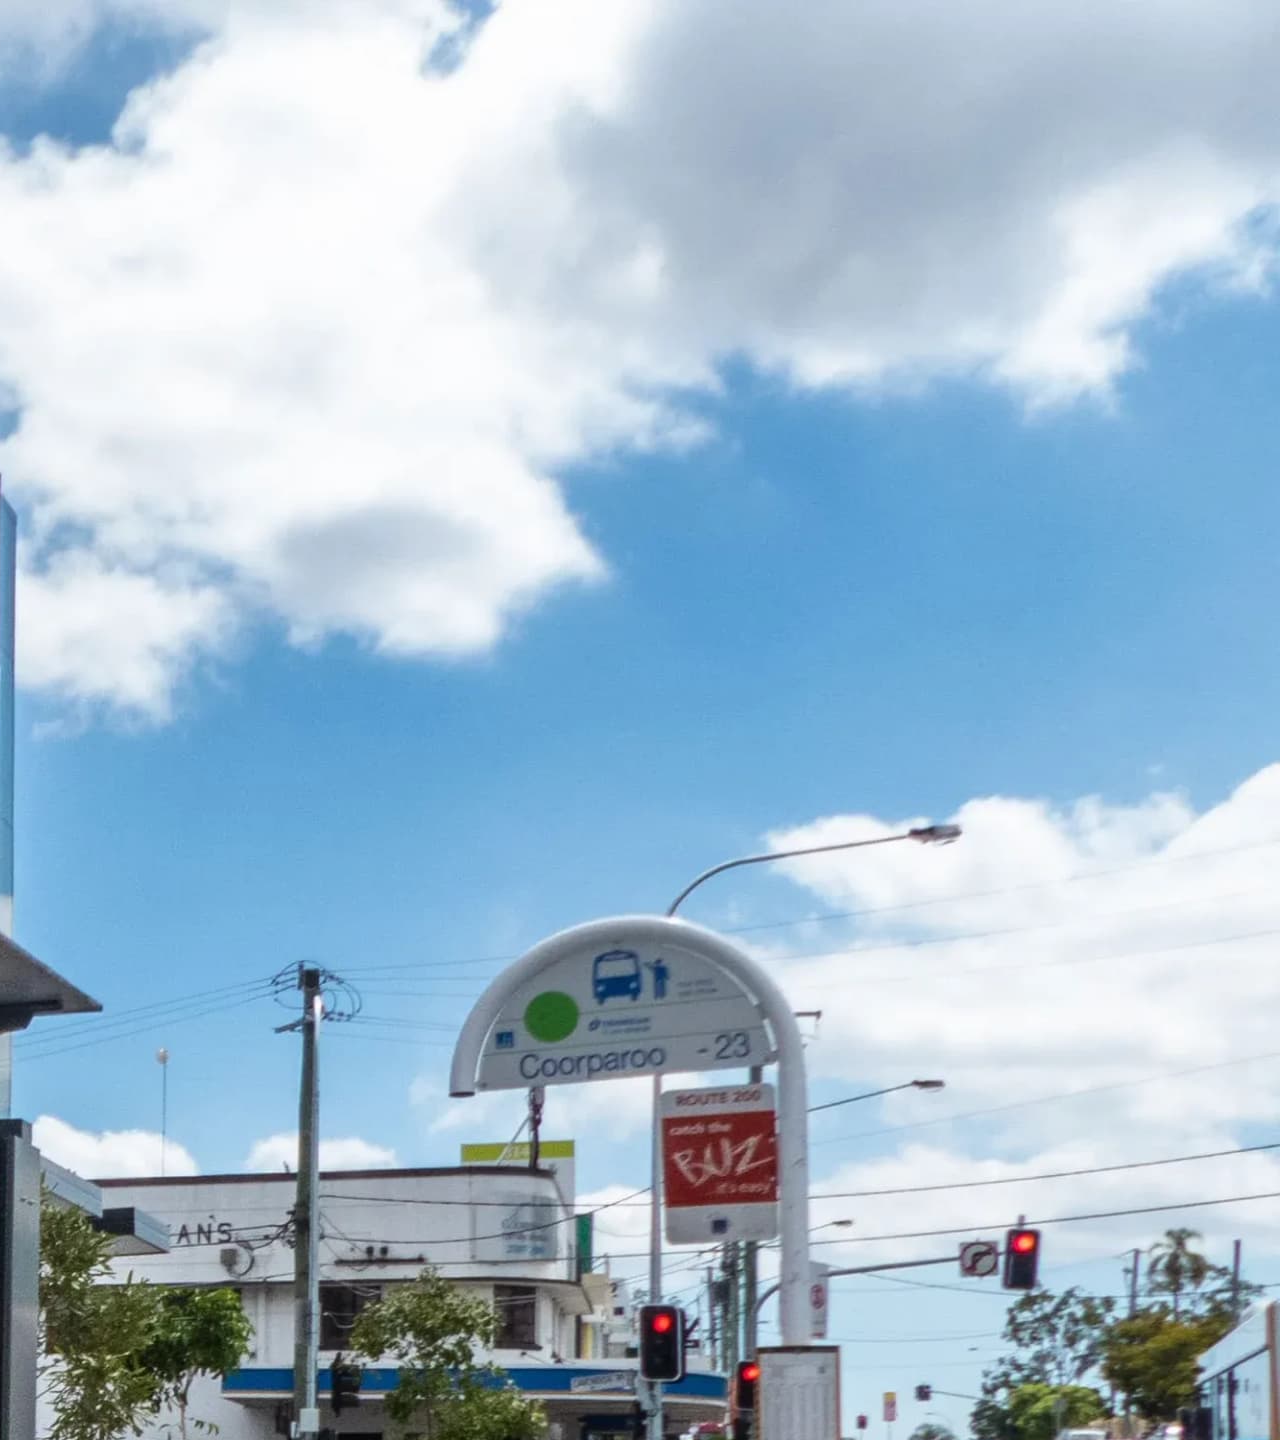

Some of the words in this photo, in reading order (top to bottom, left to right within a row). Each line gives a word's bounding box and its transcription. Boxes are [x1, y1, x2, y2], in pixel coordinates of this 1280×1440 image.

[519, 1047, 667, 1082] Coorparoo
[714, 1032, 752, 1060] 23
[675, 1091, 727, 1106] ROUTE
[168, 1222, 233, 1244] ANS
